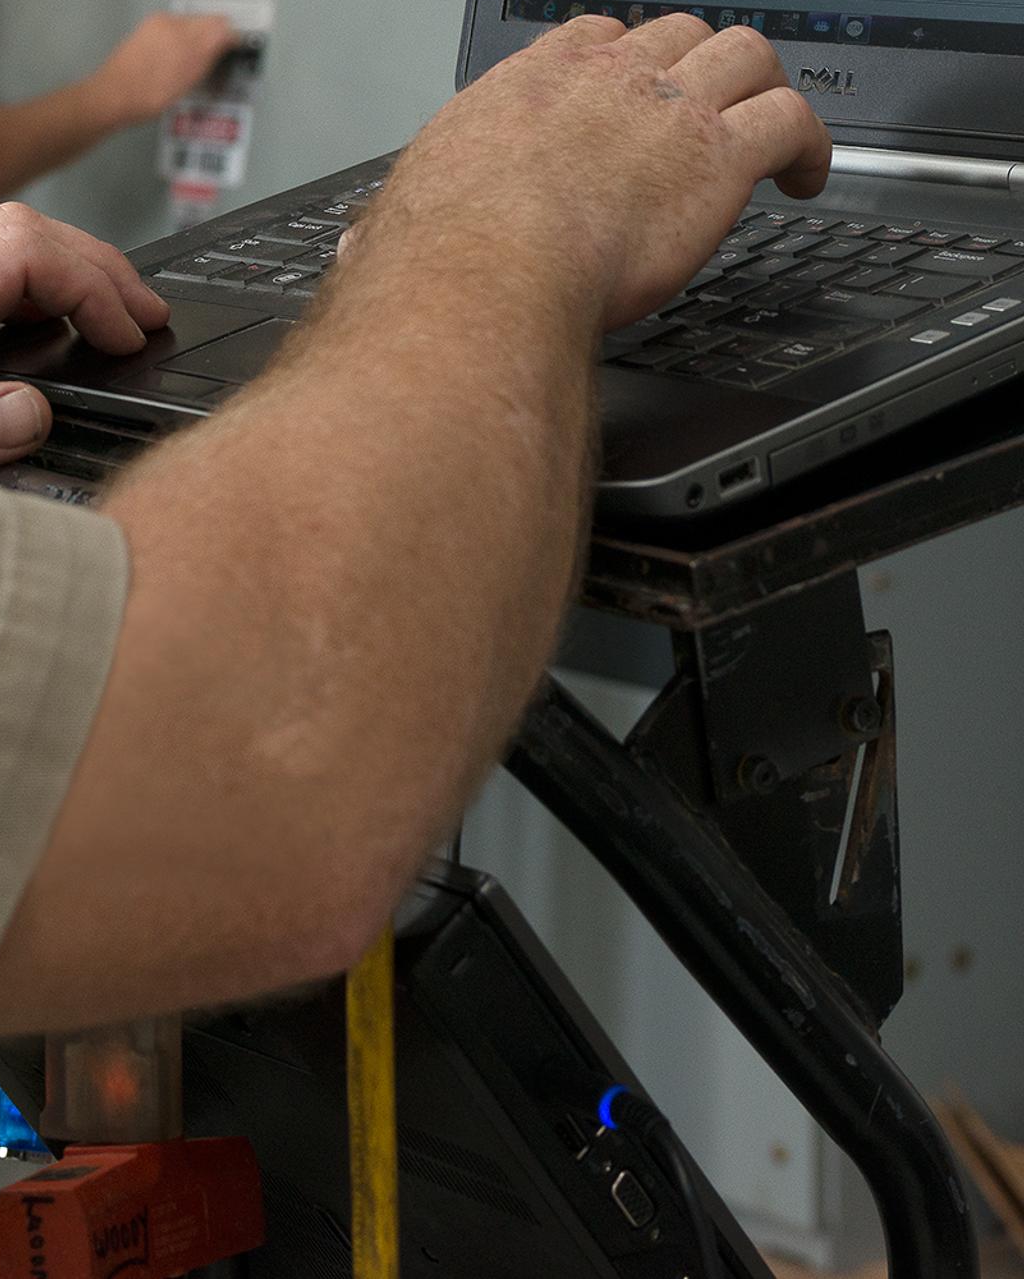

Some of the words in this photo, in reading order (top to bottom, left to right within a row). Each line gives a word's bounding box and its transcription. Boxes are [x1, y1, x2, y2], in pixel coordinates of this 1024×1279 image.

[798, 66, 857, 96] DELL
[888, 227, 913, 235] Home
[938, 250, 985, 262] Backspace
